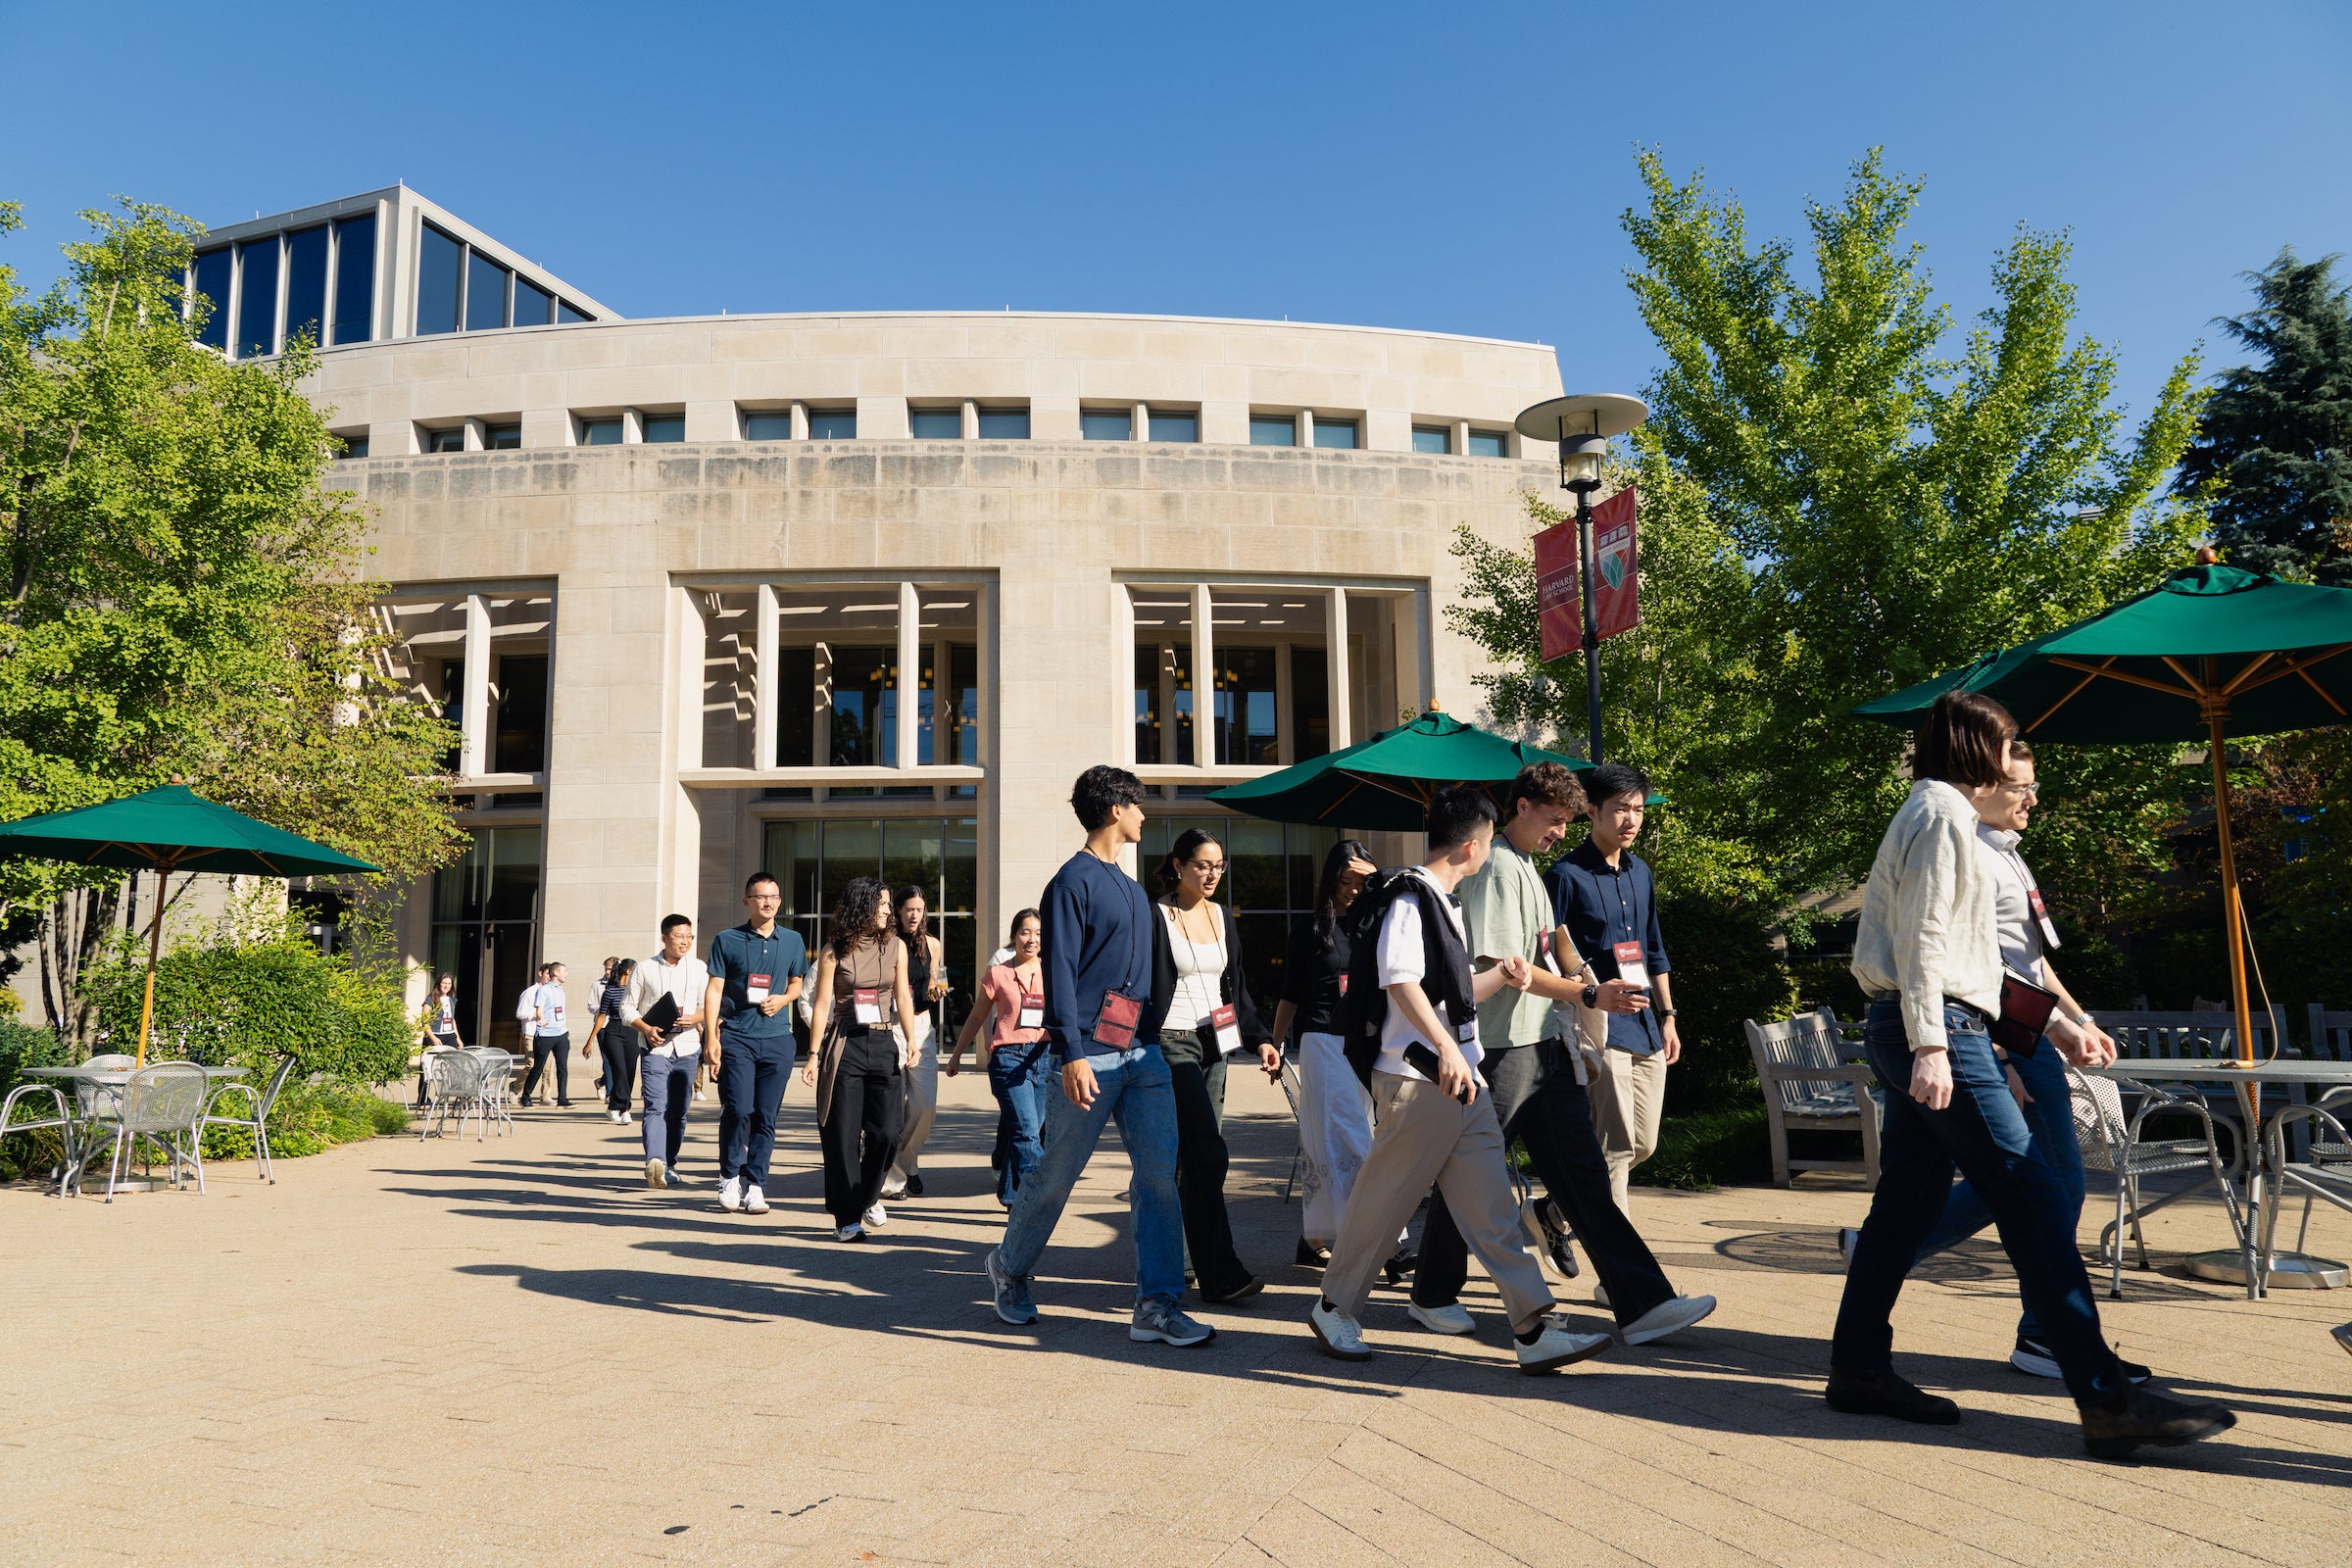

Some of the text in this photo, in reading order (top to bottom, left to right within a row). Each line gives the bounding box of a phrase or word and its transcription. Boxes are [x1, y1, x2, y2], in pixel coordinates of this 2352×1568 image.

[1543, 574, 1574, 594] HARVARD
[1553, 584, 1573, 597] SCHOOL
[1152, 1314, 1167, 1328] N
